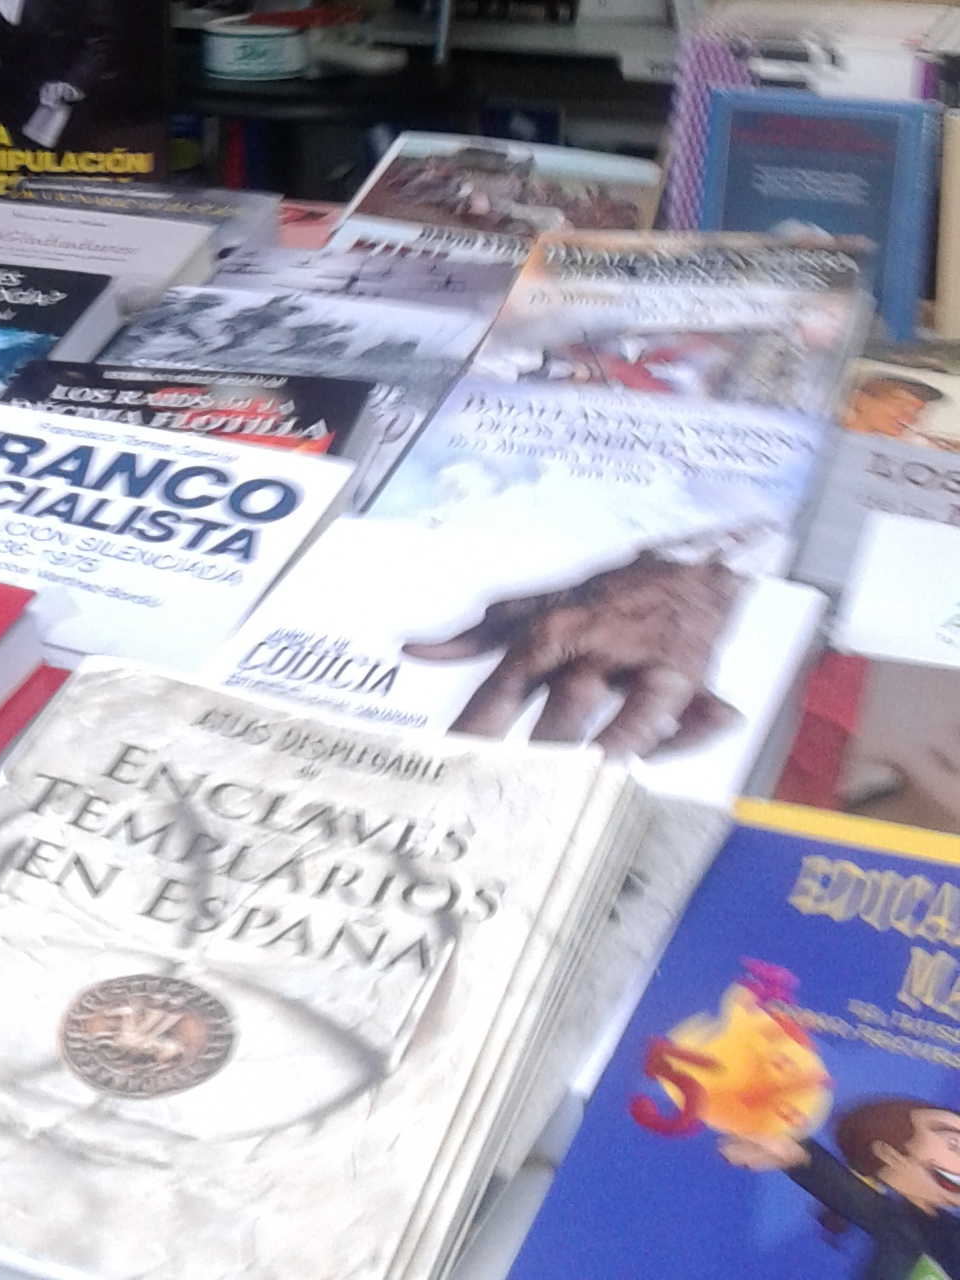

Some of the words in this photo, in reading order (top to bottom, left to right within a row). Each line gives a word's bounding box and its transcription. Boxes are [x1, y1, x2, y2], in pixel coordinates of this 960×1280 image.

[147, 408, 330, 441] FLOTILLA
[75, 534, 246, 587] SILENCIADA
[235, 639, 404, 699] CODICIA
[101, 739, 478, 864] ENCLAVES
[14, 835, 122, 900] EN
[26, 773, 507, 923] TEMPLARIOS
